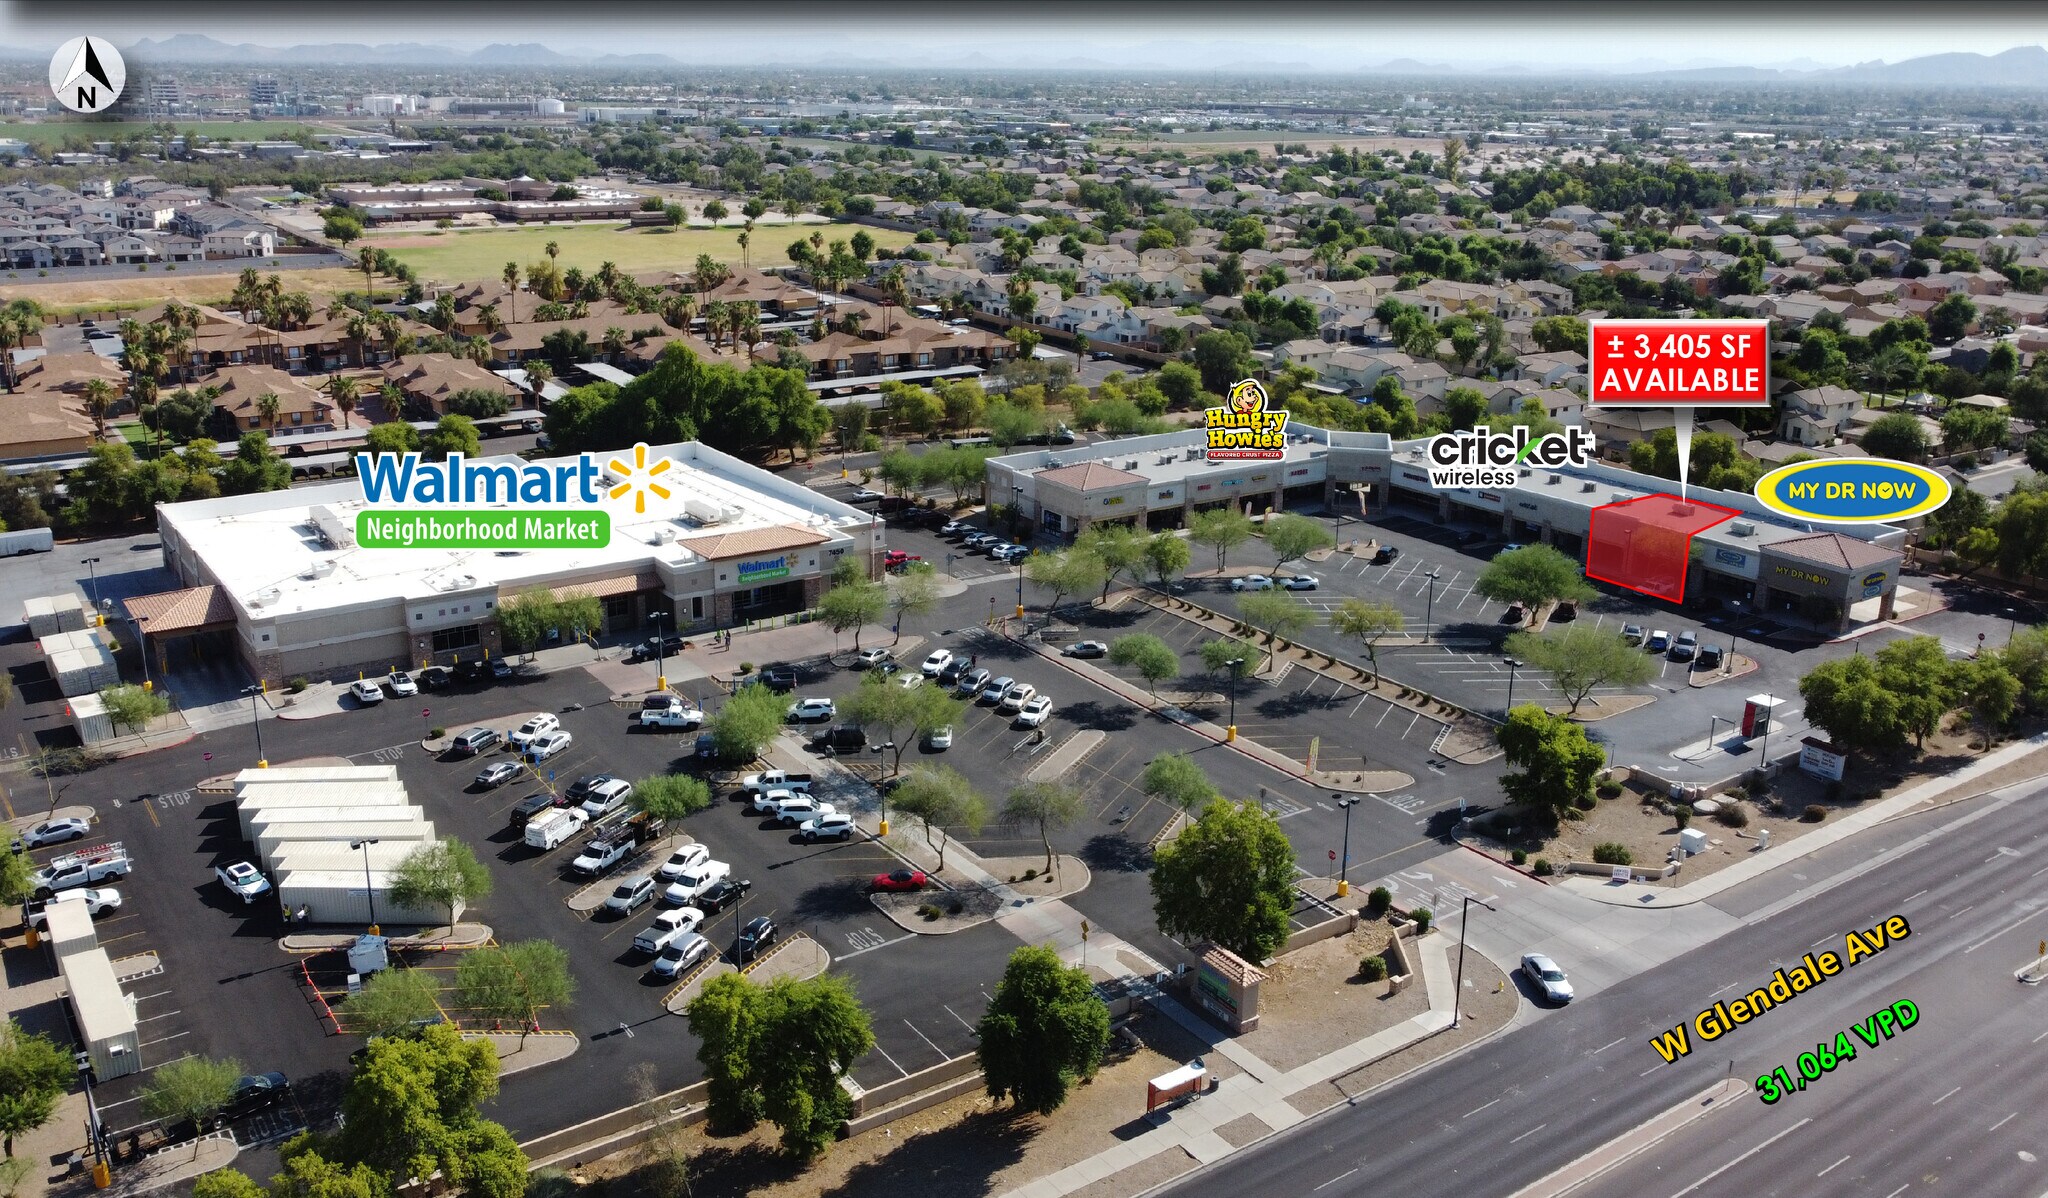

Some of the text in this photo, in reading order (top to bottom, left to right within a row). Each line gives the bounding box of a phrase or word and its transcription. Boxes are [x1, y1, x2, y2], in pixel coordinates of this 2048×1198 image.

[738, 556, 785, 573] Walmart
[1775, 565, 1830, 586] MY DR NOW
[374, 747, 404, 763] STOP
[158, 791, 192, 809] STOP
[845, 926, 886, 950] STOP
